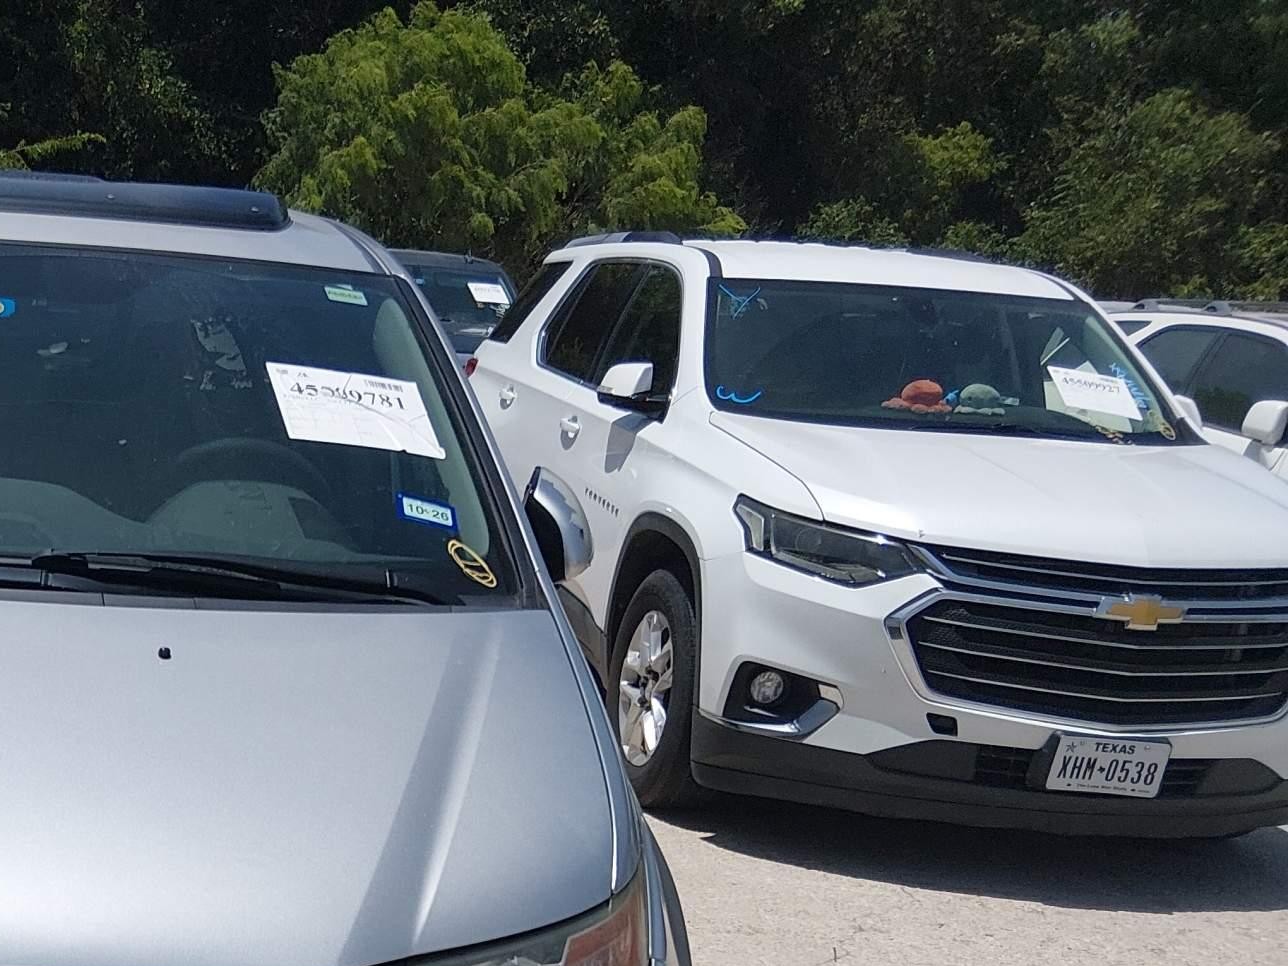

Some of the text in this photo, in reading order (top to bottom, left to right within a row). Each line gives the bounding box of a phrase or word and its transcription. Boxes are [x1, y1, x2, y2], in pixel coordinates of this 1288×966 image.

[1095, 742, 1136, 755] TEXAS
[1057, 755, 1158, 786] XHM 0538
